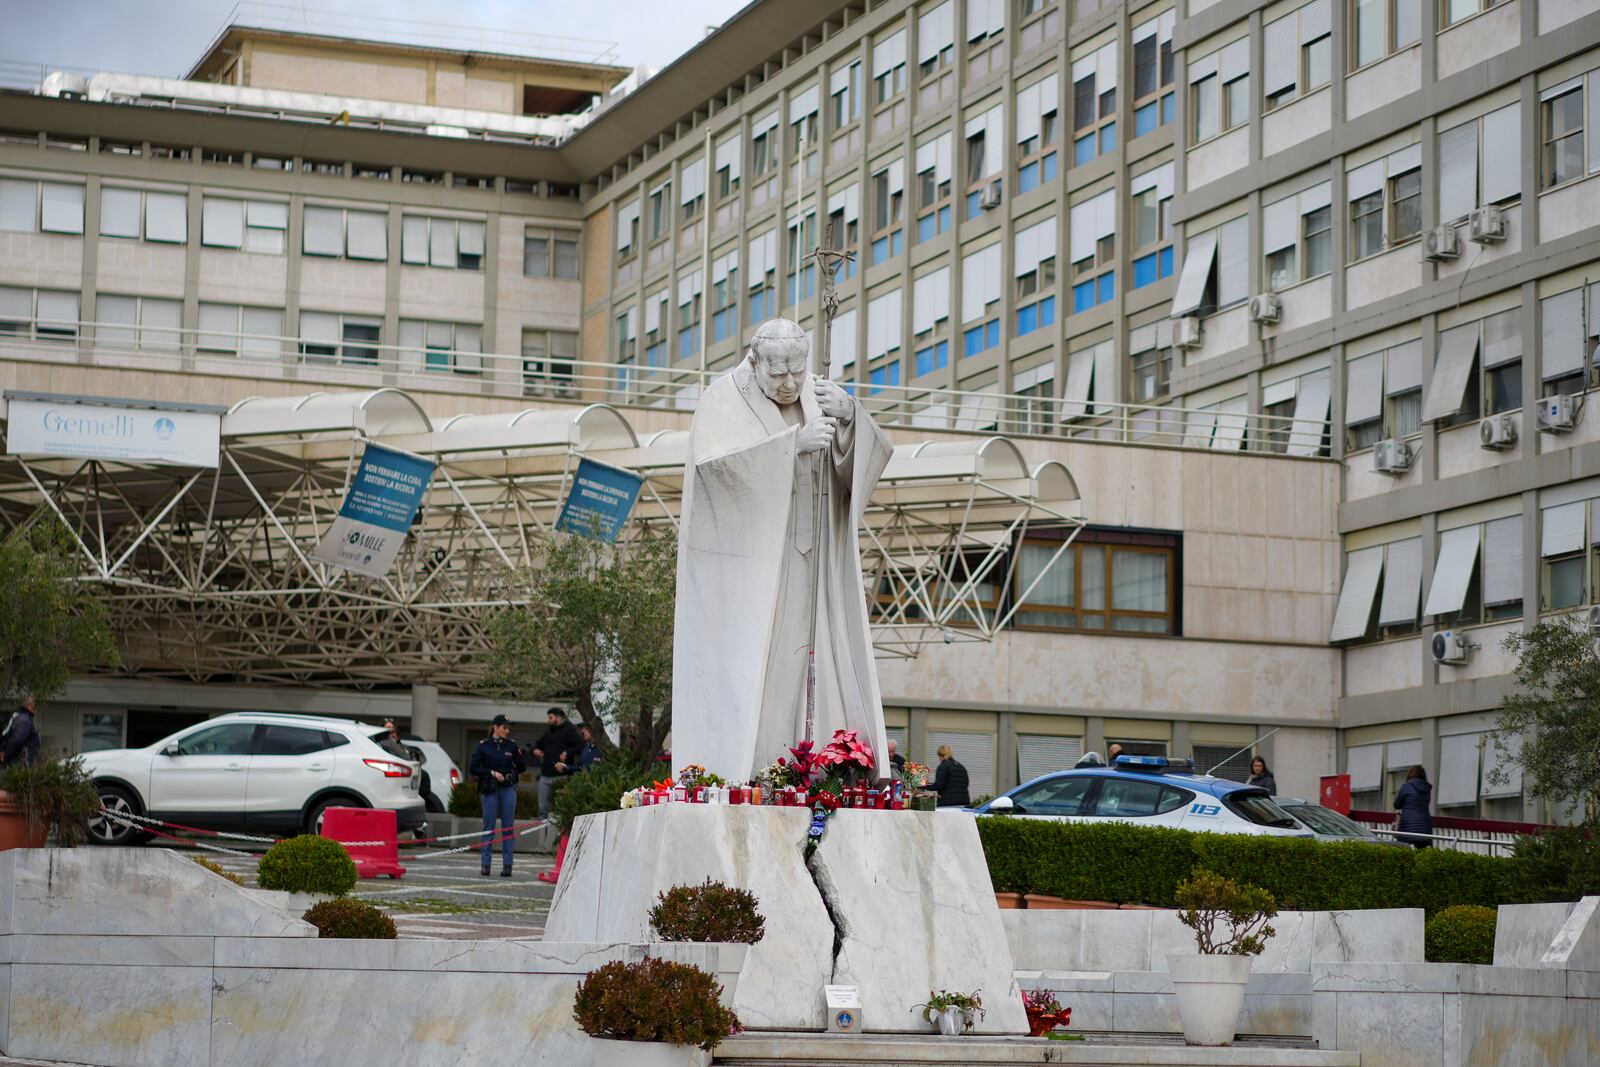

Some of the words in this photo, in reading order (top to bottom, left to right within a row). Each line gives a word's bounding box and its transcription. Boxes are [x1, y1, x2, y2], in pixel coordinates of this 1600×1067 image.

[43, 409, 134, 438] Gemelli
[365, 463, 378, 473] NON
[378, 466, 401, 480] FERMARE
[400, 472, 408, 481] LA
[386, 480, 394, 489] LA
[1190, 803, 1221, 816] 113
